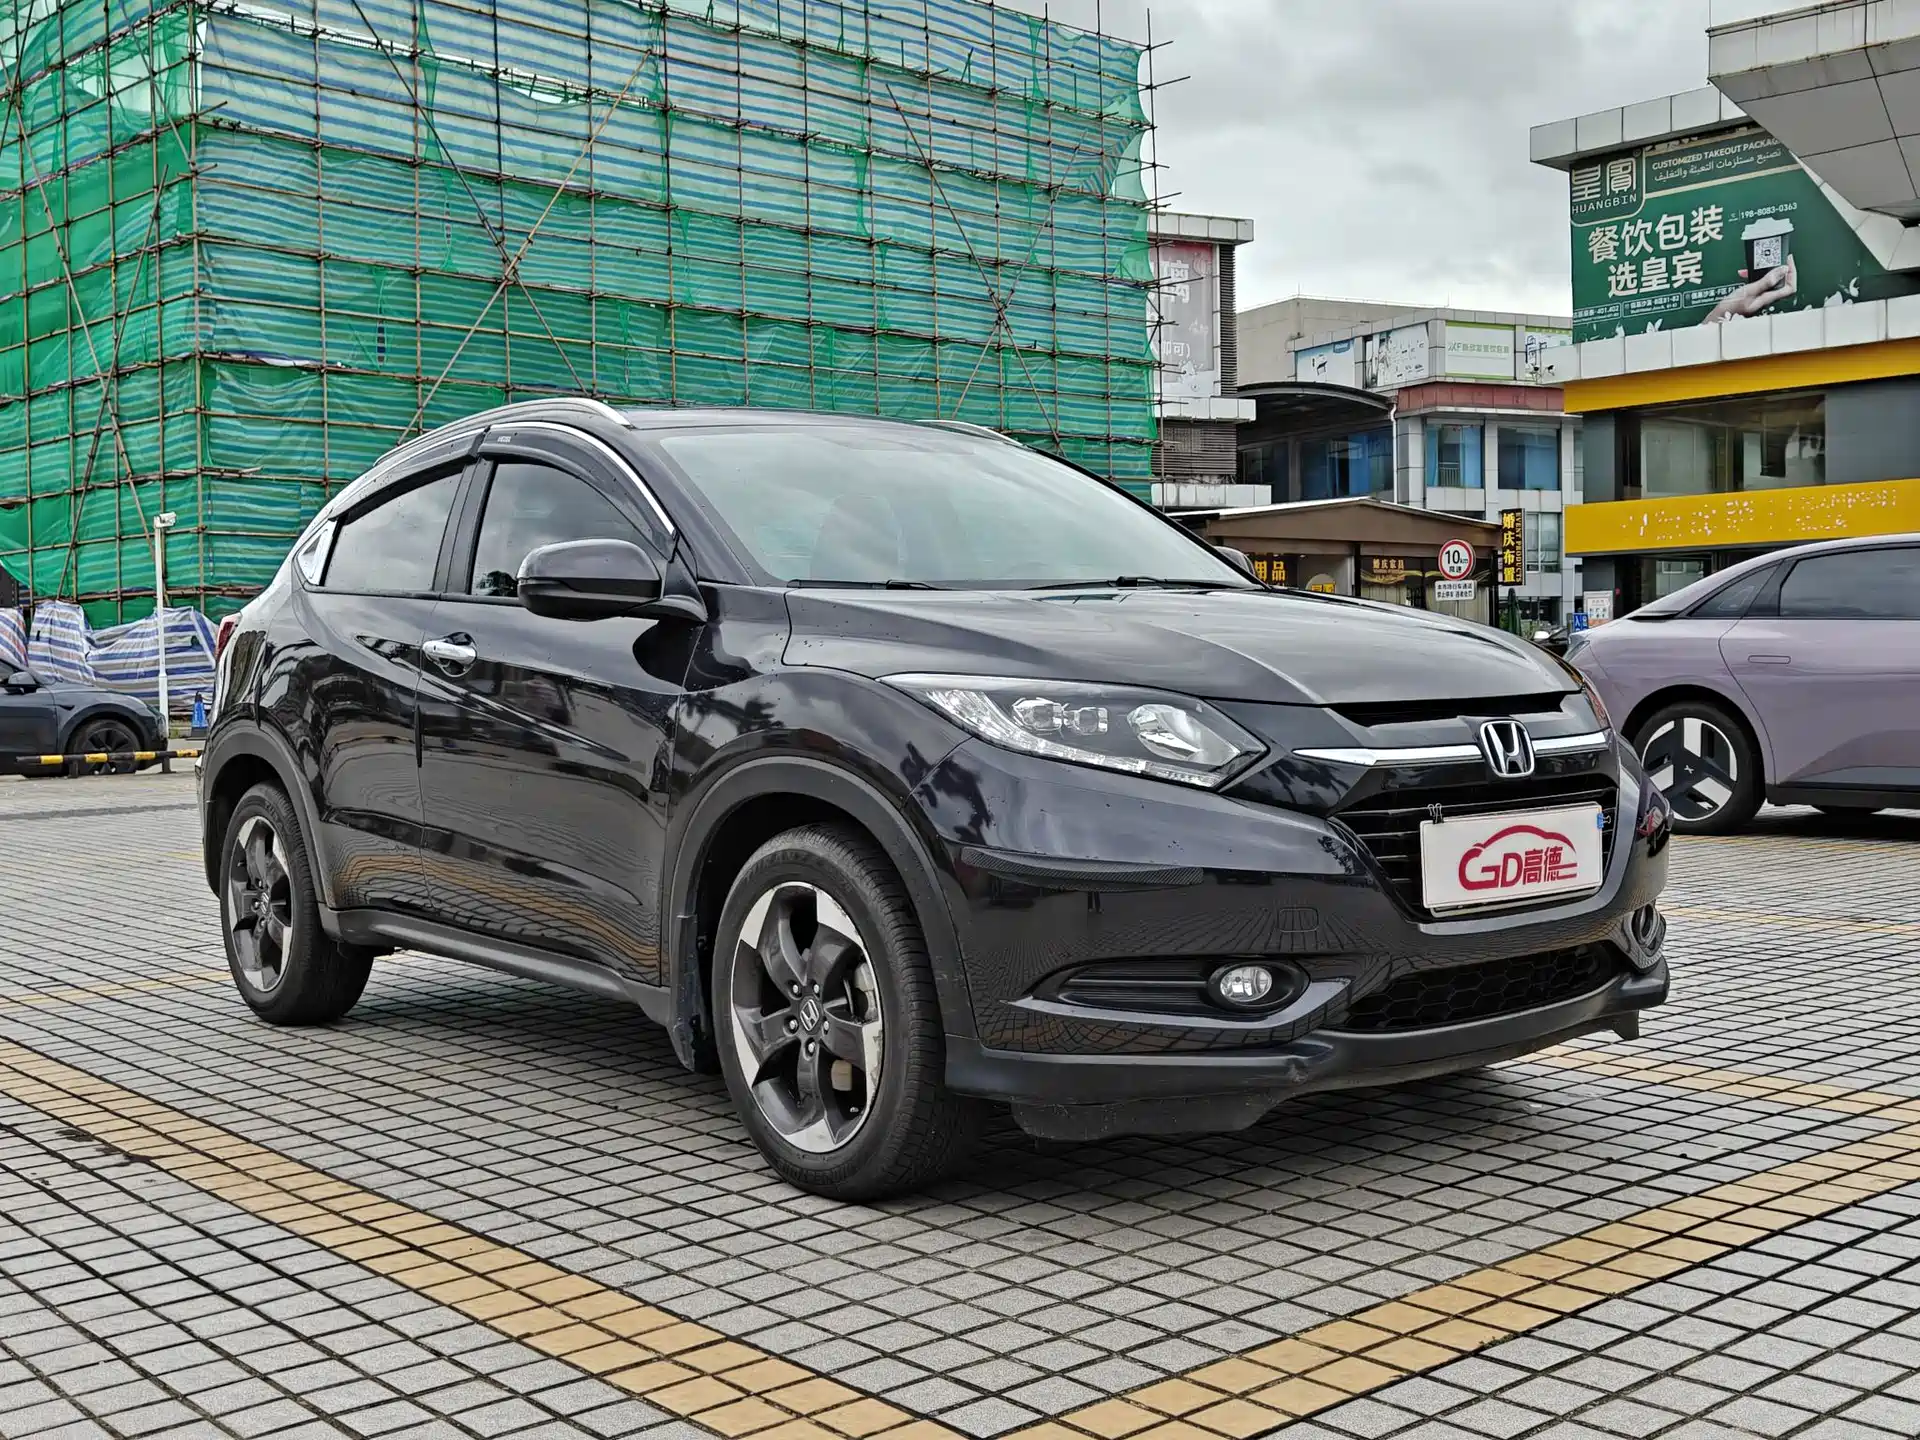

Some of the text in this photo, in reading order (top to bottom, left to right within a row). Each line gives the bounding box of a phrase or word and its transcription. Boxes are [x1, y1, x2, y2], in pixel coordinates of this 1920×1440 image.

[1652, 152, 1702, 170] CUSTOMIZED
[1704, 144, 1742, 159] TAKEOUT
[1572, 194, 1637, 214] HUANGBIN
[1740, 202, 1798, 219] 198-8083-0363
[1588, 204, 1724, 264] 餐饮包装
[1608, 250, 1704, 298] 选皇宾
[1503, 512, 1515, 583] 婚庆布置
